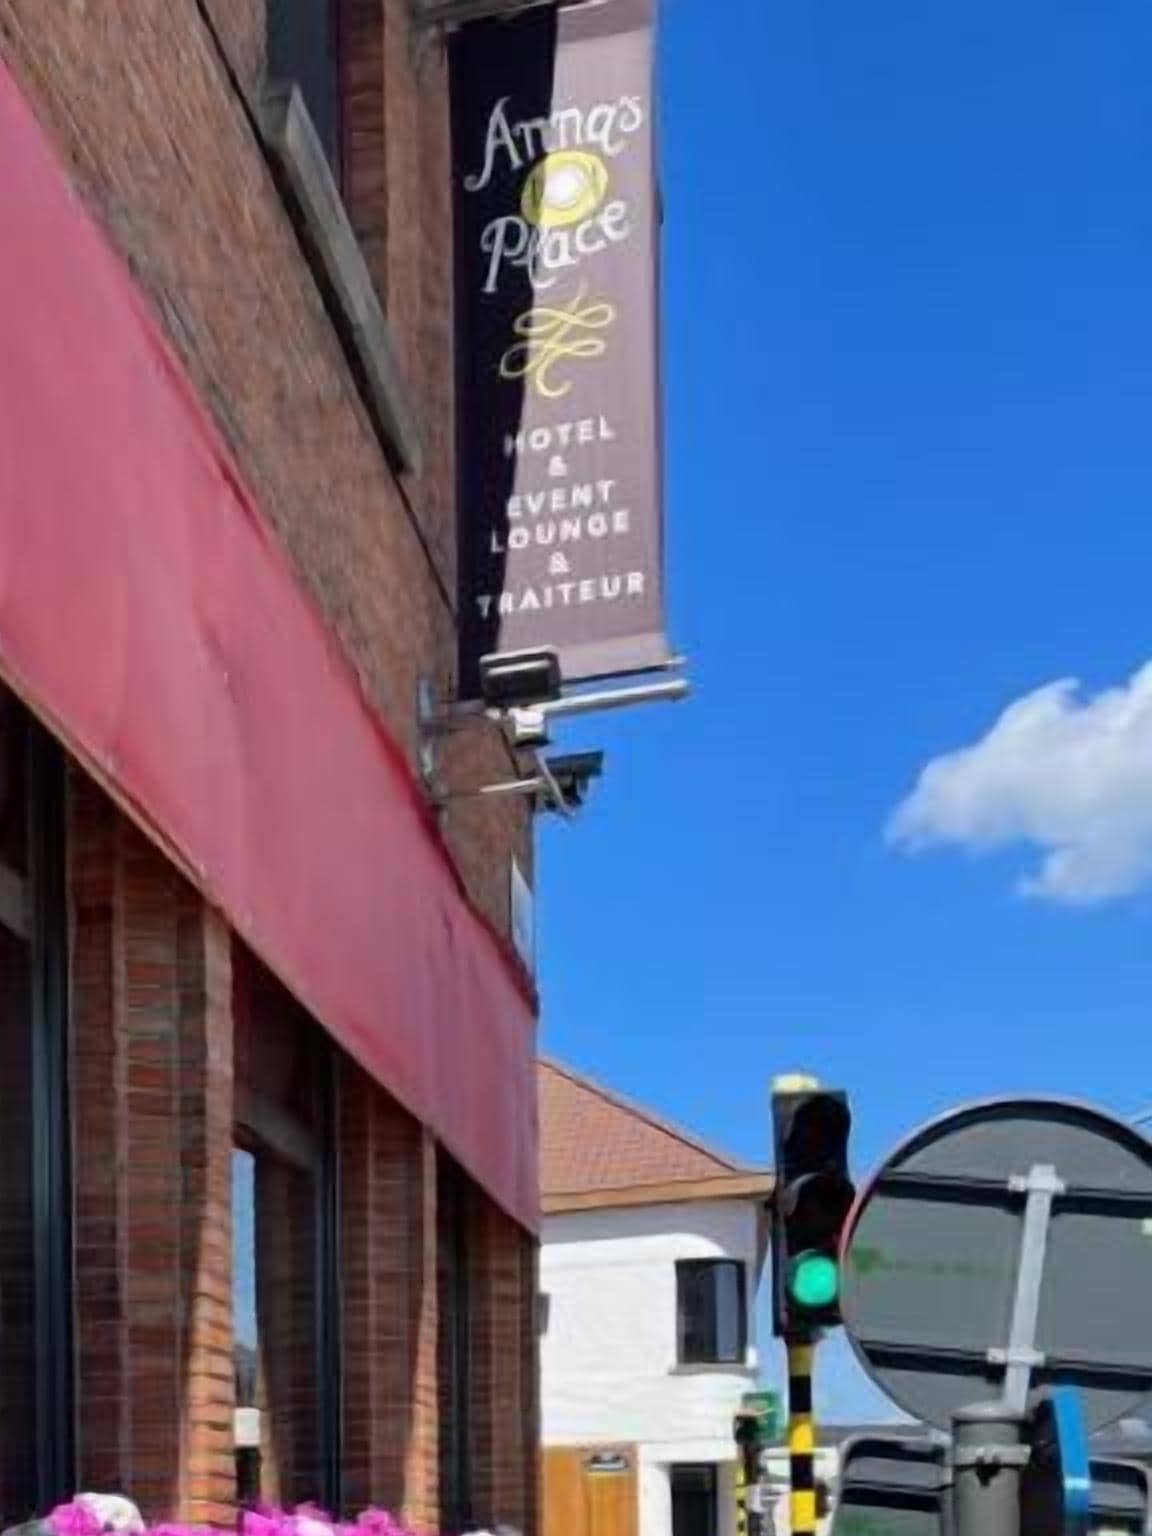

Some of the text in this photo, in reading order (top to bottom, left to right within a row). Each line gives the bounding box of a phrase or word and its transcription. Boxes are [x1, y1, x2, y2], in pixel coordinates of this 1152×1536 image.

[480, 200, 630, 293] Place
[504, 415, 616, 458] HOTEL
[549, 455, 568, 477] &
[507, 480, 615, 518] EVENT
[491, 508, 630, 554] LOUNGE
[550, 552, 570, 575] &
[476, 572, 645, 619] TRAITEUR
